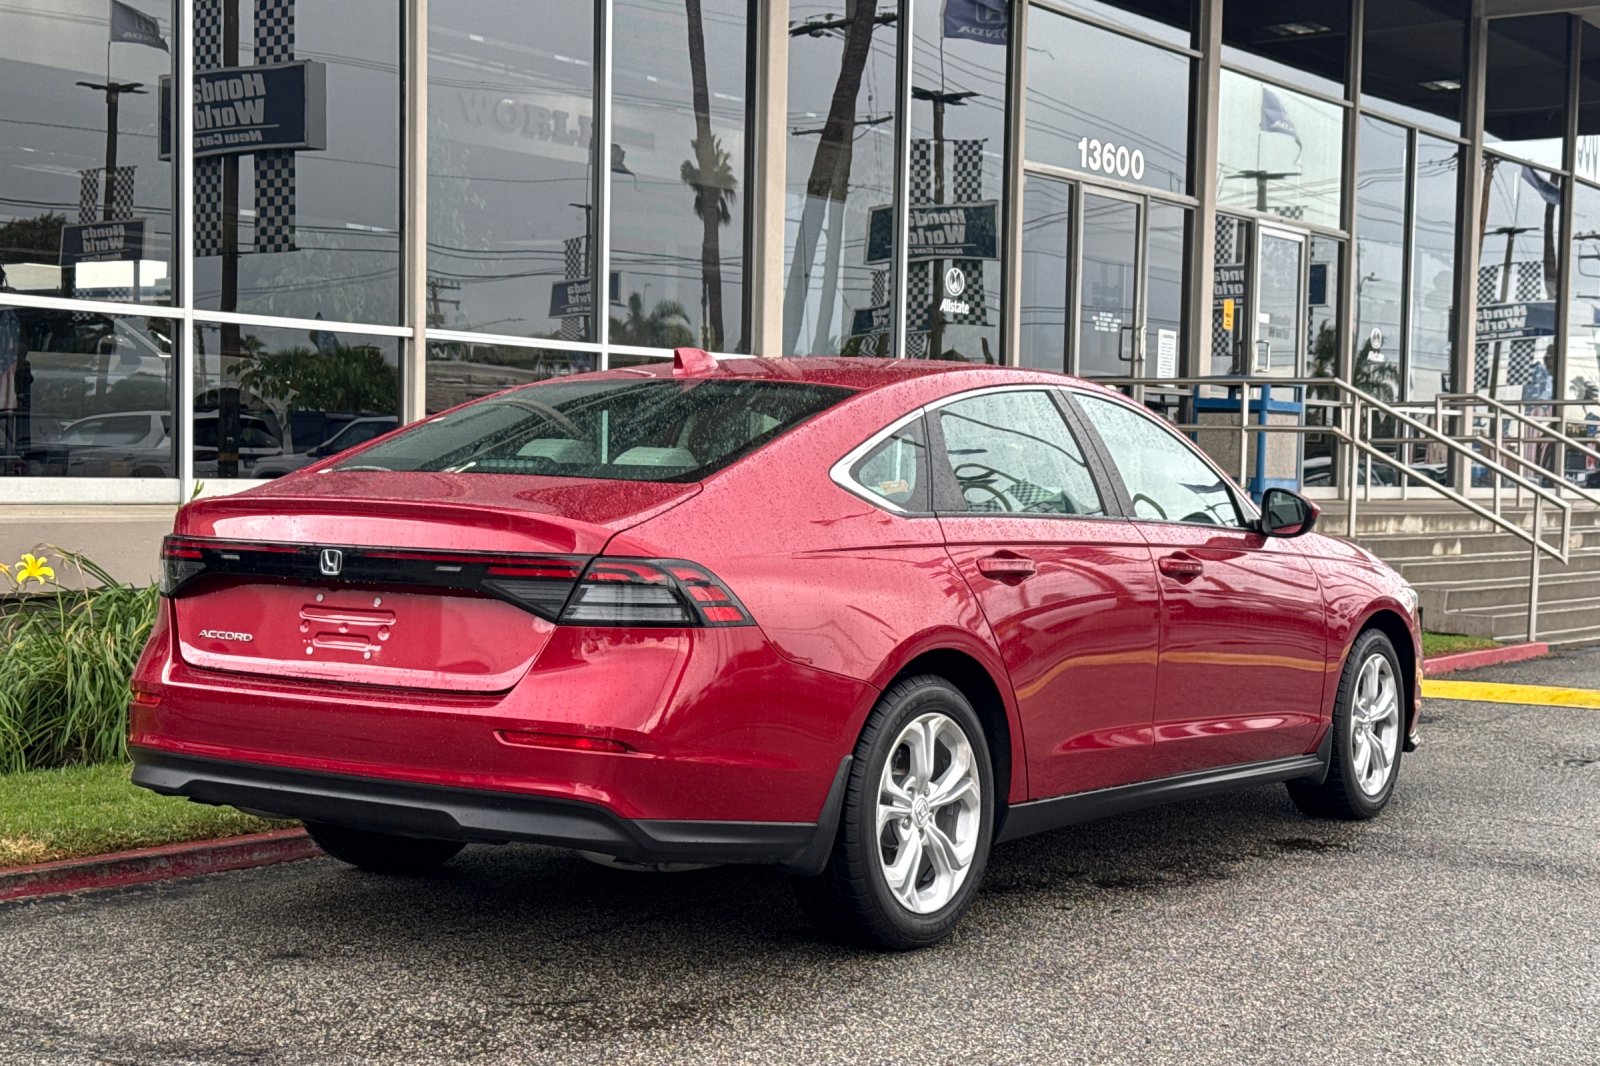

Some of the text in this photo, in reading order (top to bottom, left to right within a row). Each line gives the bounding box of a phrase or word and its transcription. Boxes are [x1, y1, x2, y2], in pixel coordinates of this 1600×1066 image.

[1078, 137, 1144, 180] 13600
[940, 298, 969, 314] Allstate
[199, 628, 253, 642] ACCORD
